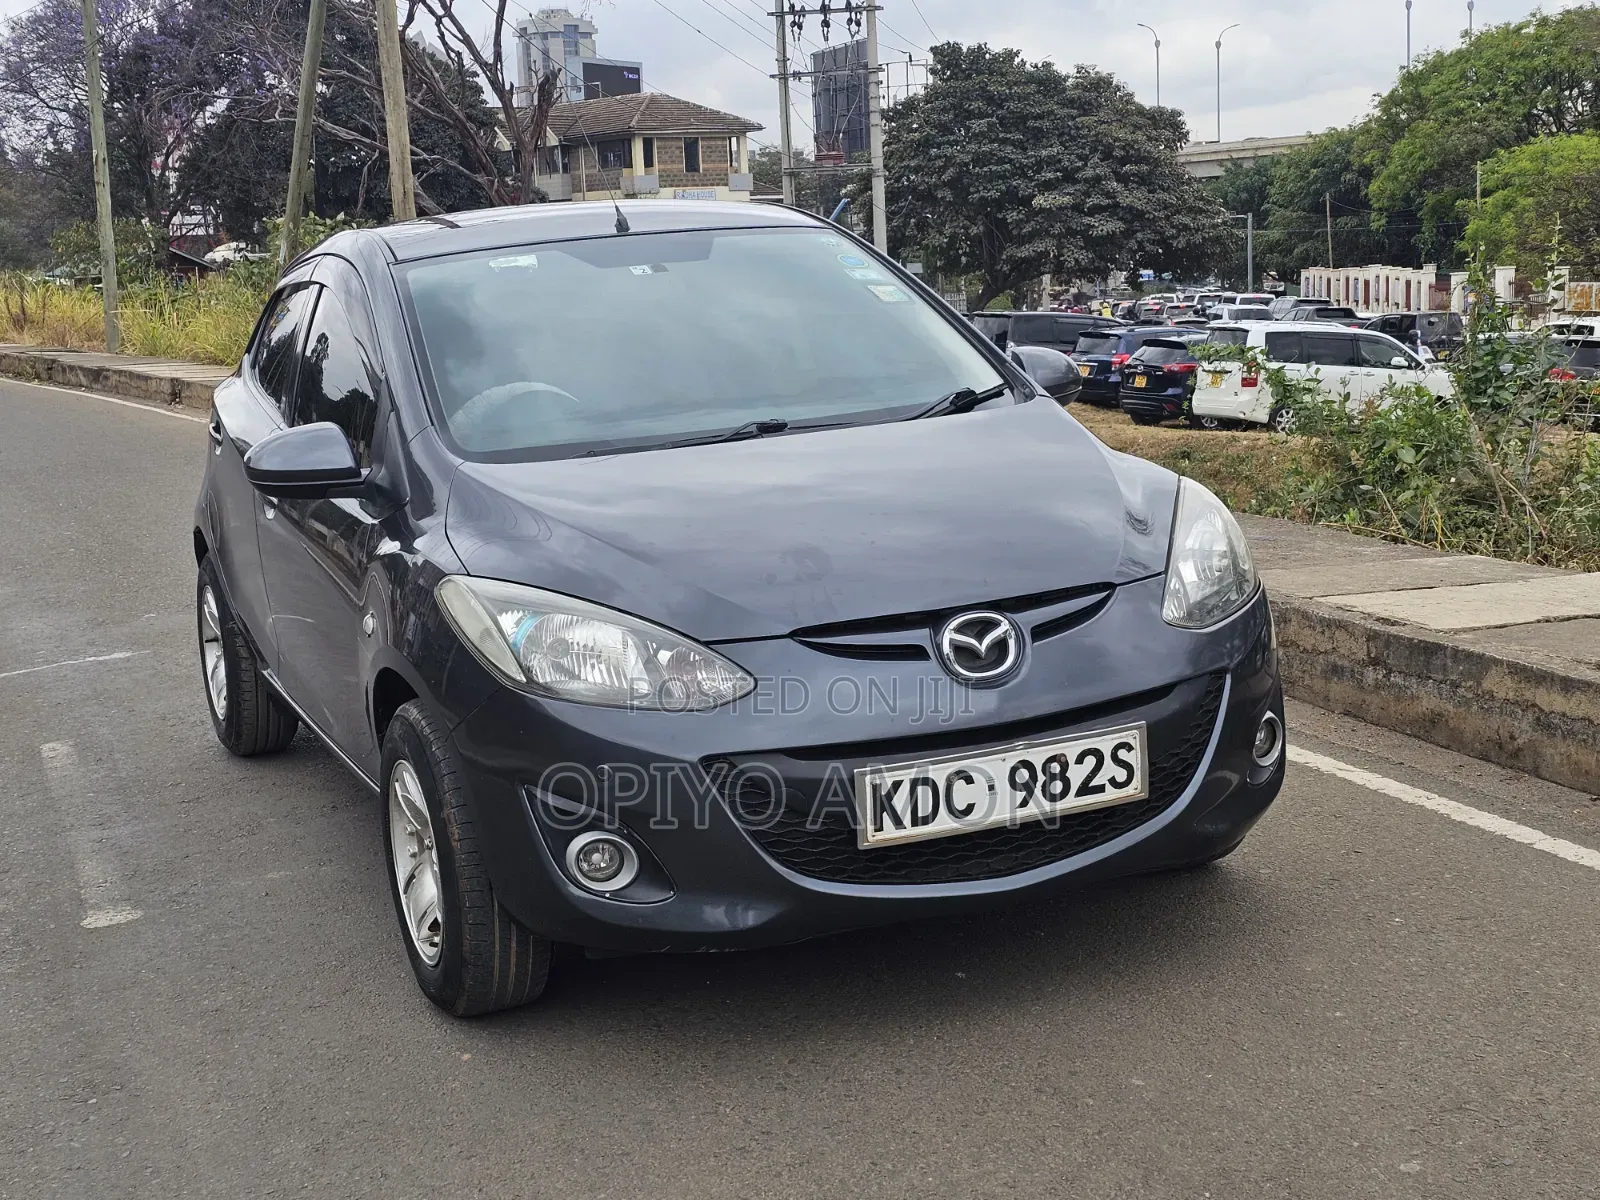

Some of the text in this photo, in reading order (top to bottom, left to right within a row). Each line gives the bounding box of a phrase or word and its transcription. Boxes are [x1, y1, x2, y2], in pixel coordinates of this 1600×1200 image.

[697, 190, 715, 198] HOUSE
[871, 741, 1135, 832] KDC 982S
